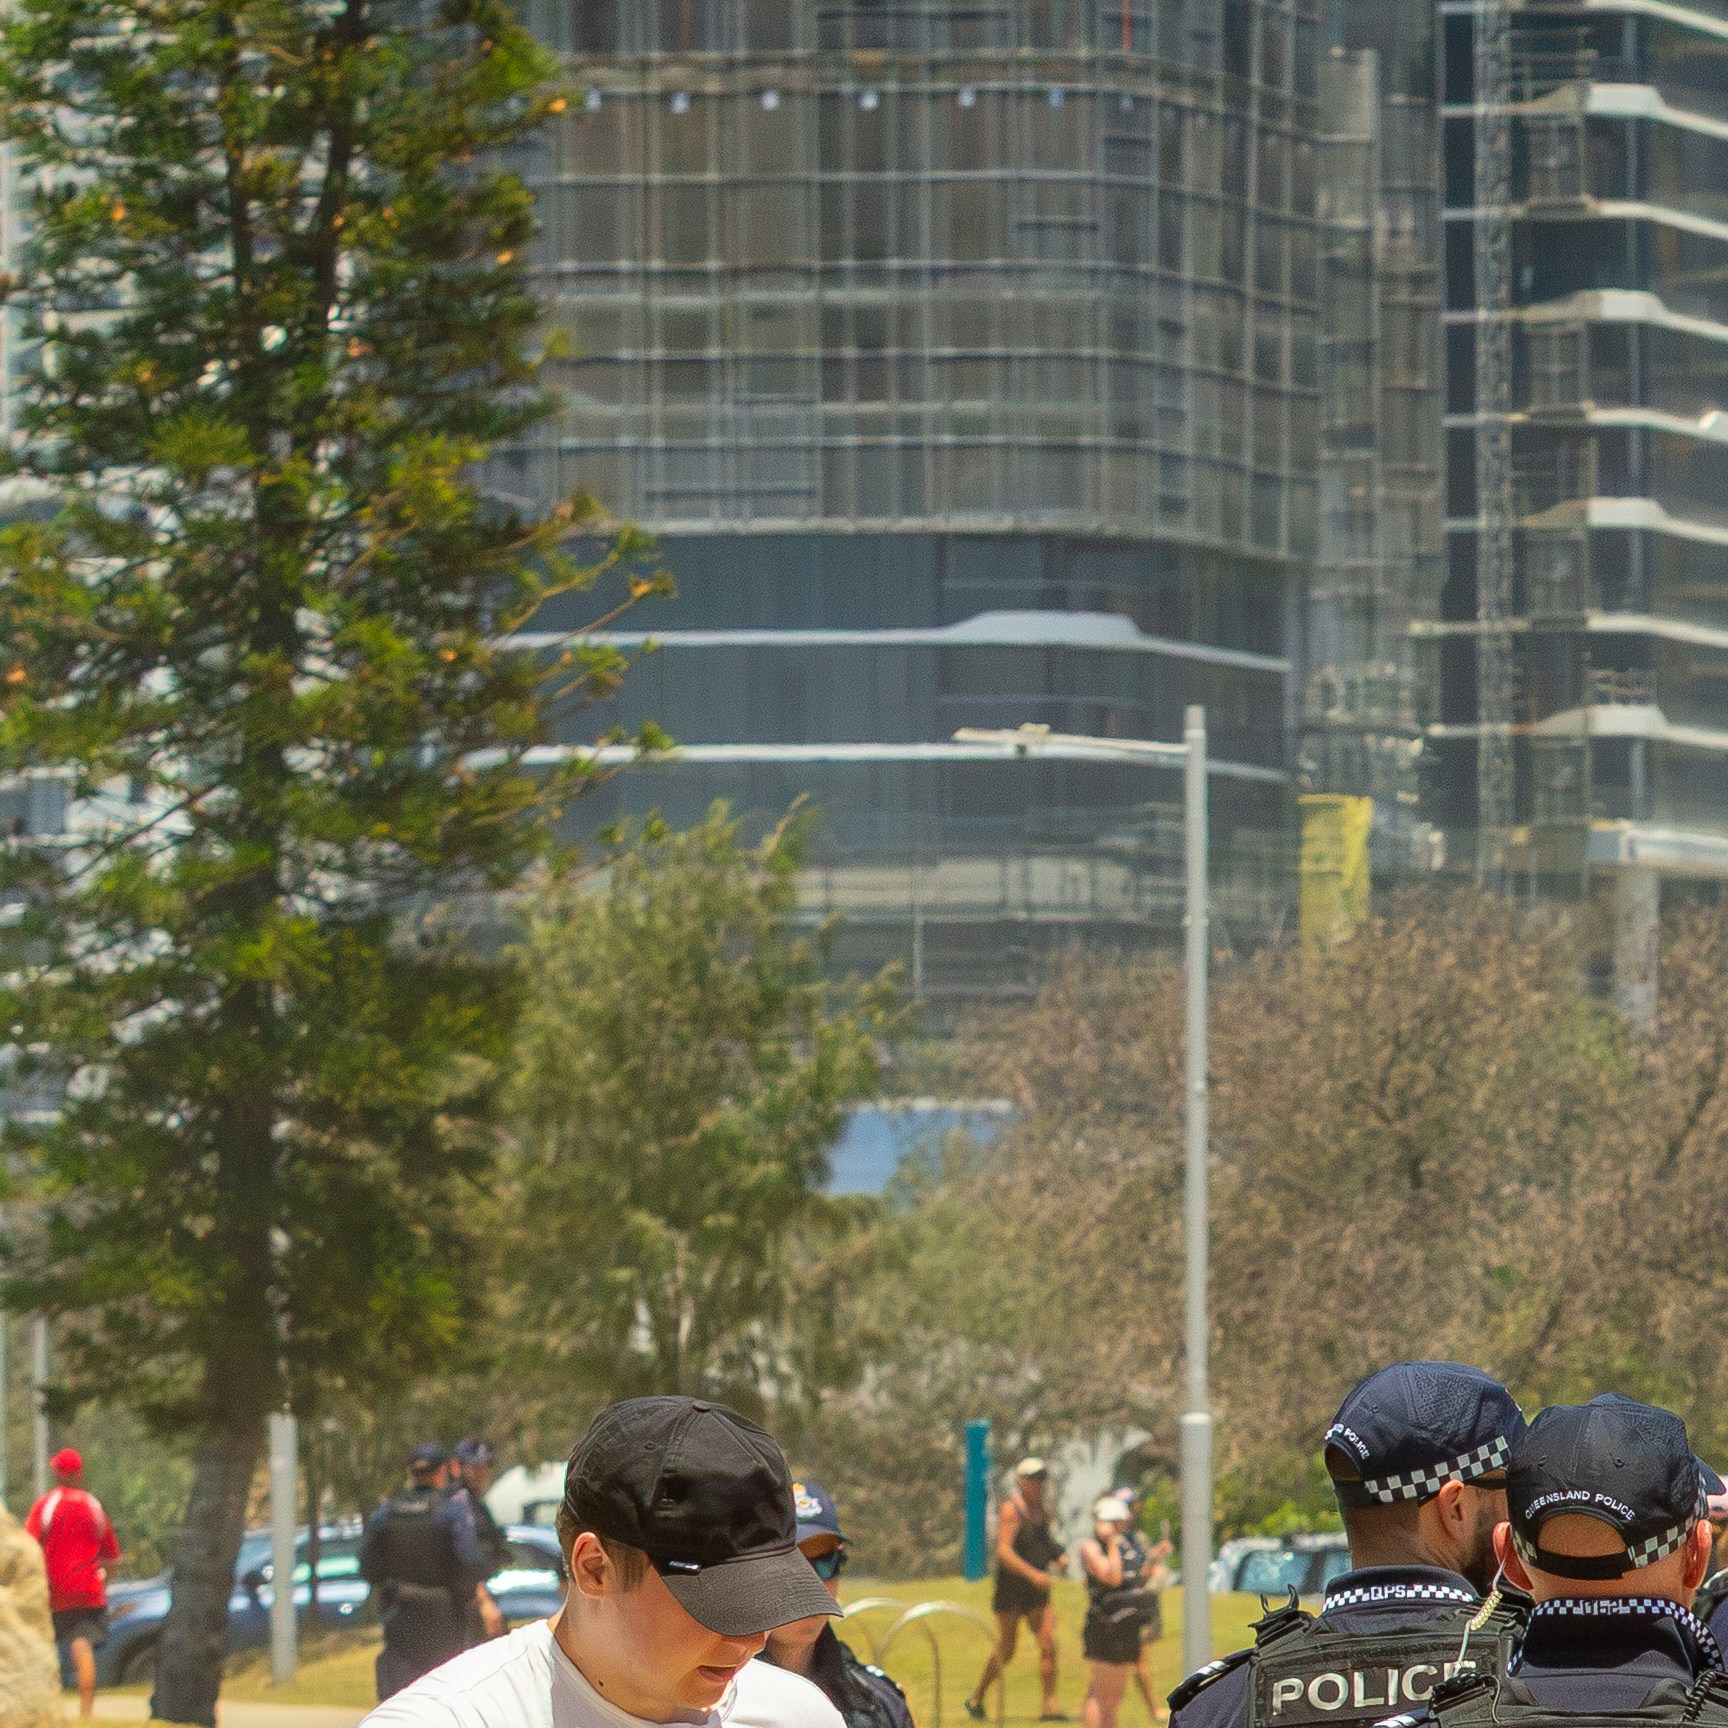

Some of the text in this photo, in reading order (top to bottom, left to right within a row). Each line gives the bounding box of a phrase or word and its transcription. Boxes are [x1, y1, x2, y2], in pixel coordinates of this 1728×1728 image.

[1525, 1490, 1636, 1521] QUEENSLAND POLICE
[1370, 1584, 1406, 1600] QPS
